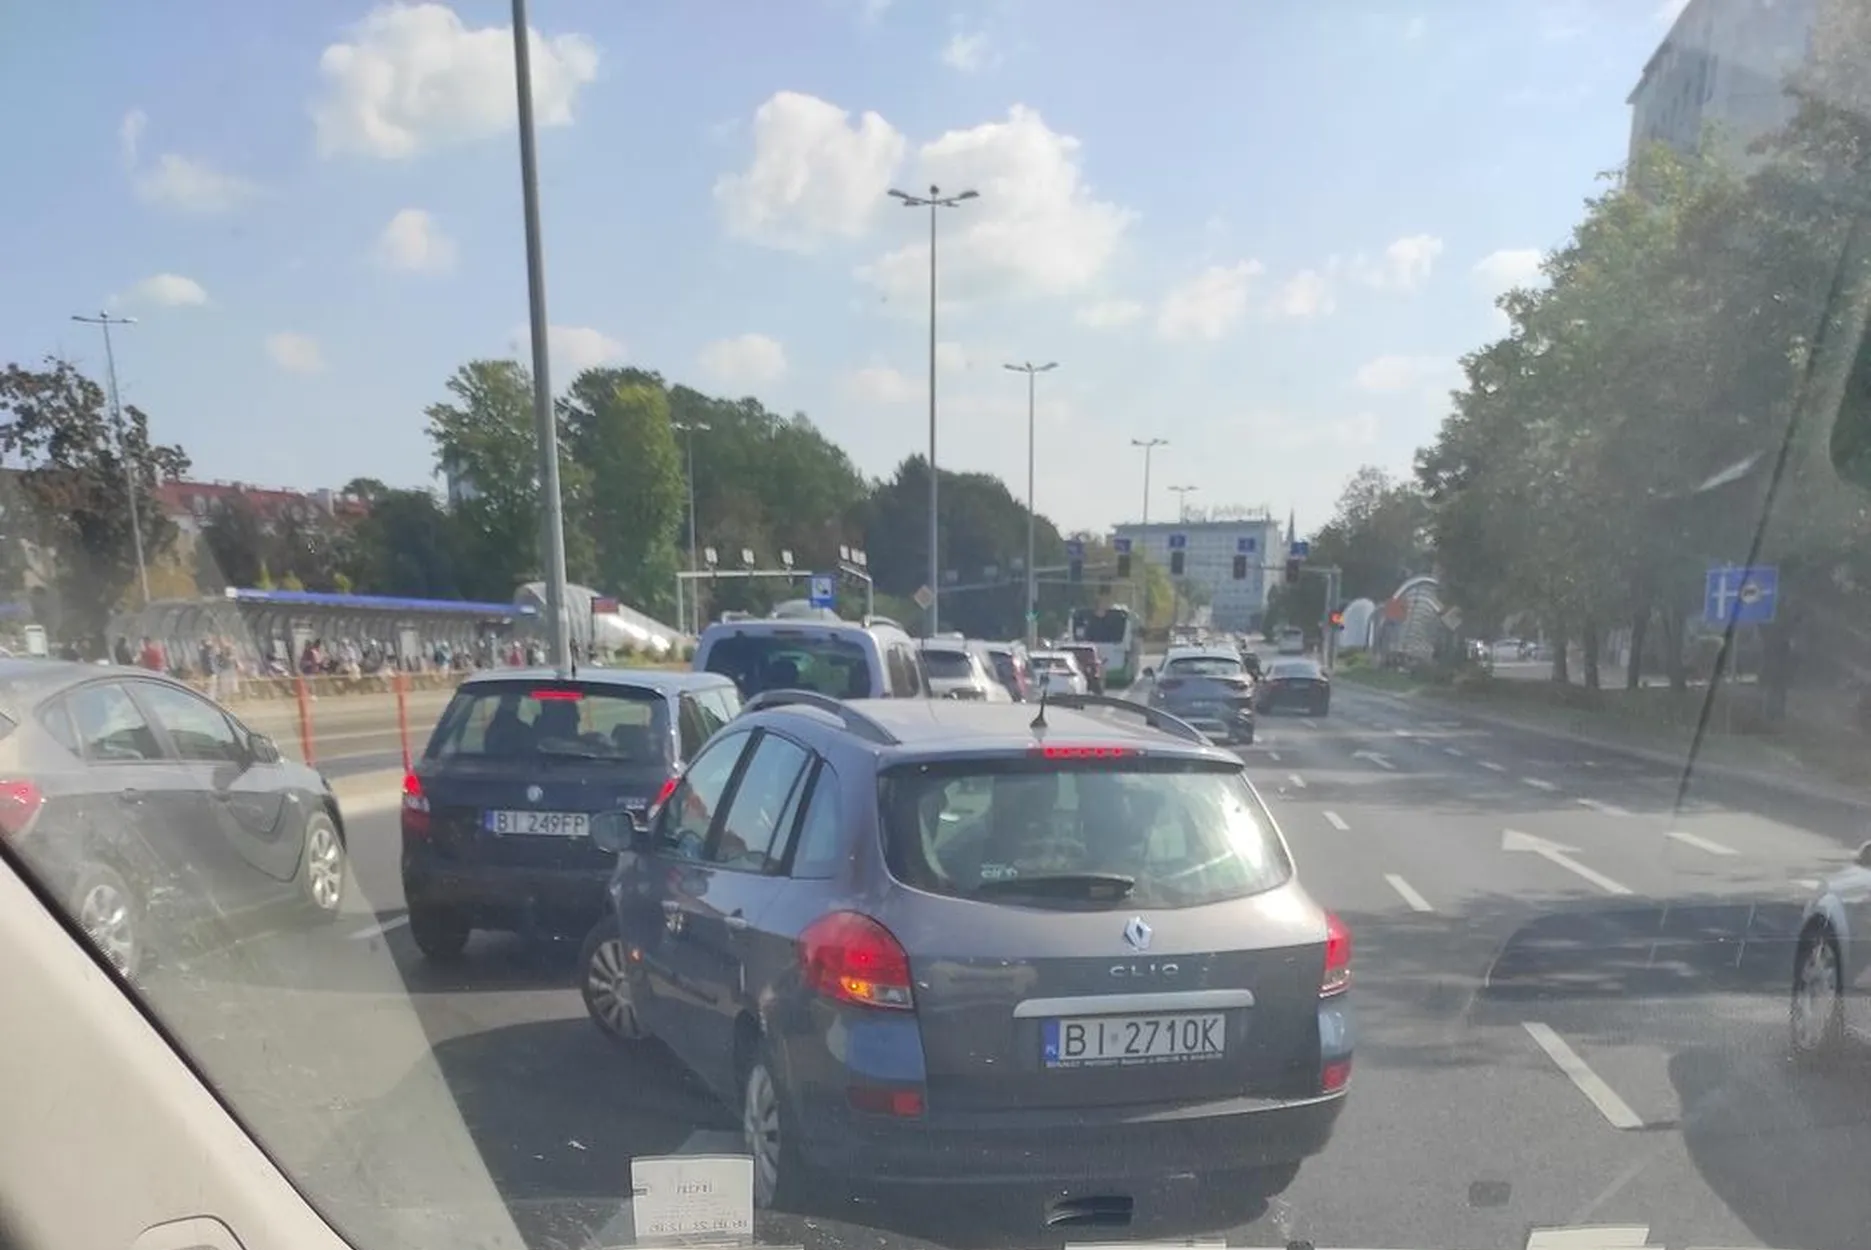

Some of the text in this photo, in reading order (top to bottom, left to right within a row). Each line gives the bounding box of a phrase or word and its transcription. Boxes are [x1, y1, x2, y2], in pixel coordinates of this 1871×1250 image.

[1109, 964, 1179, 978] CLIO
[1065, 1018, 1219, 1056] BI 2710K
